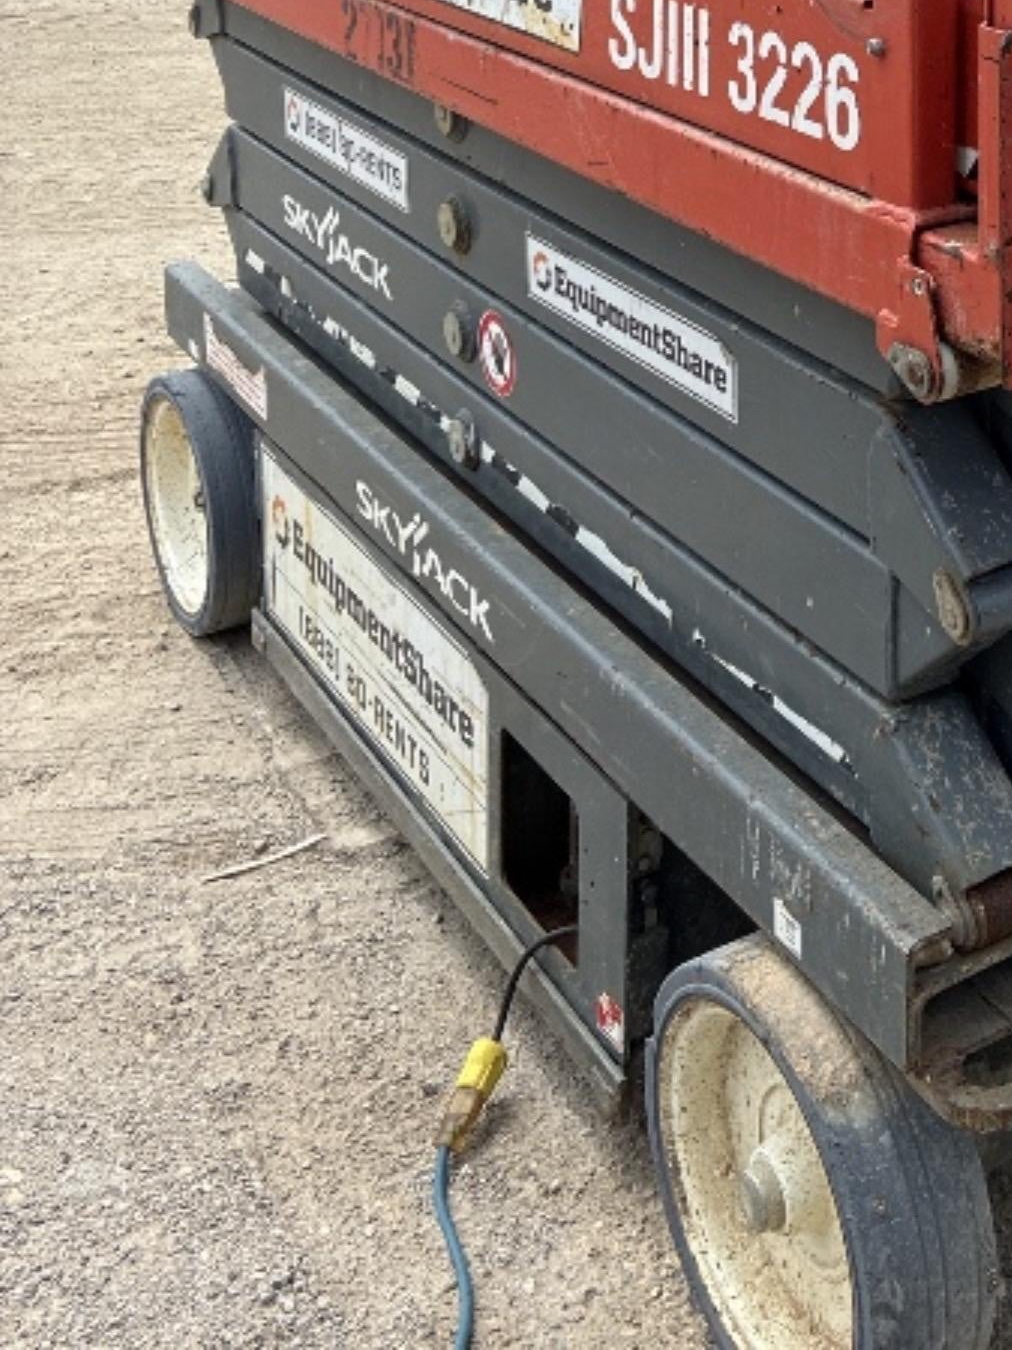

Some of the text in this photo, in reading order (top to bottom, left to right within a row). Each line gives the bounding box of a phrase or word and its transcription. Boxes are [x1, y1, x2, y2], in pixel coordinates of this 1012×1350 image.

[727, 20, 862, 151] 3226
[552, 263, 729, 398] EquipmentShare
[292, 518, 476, 750] EquipmentShare
